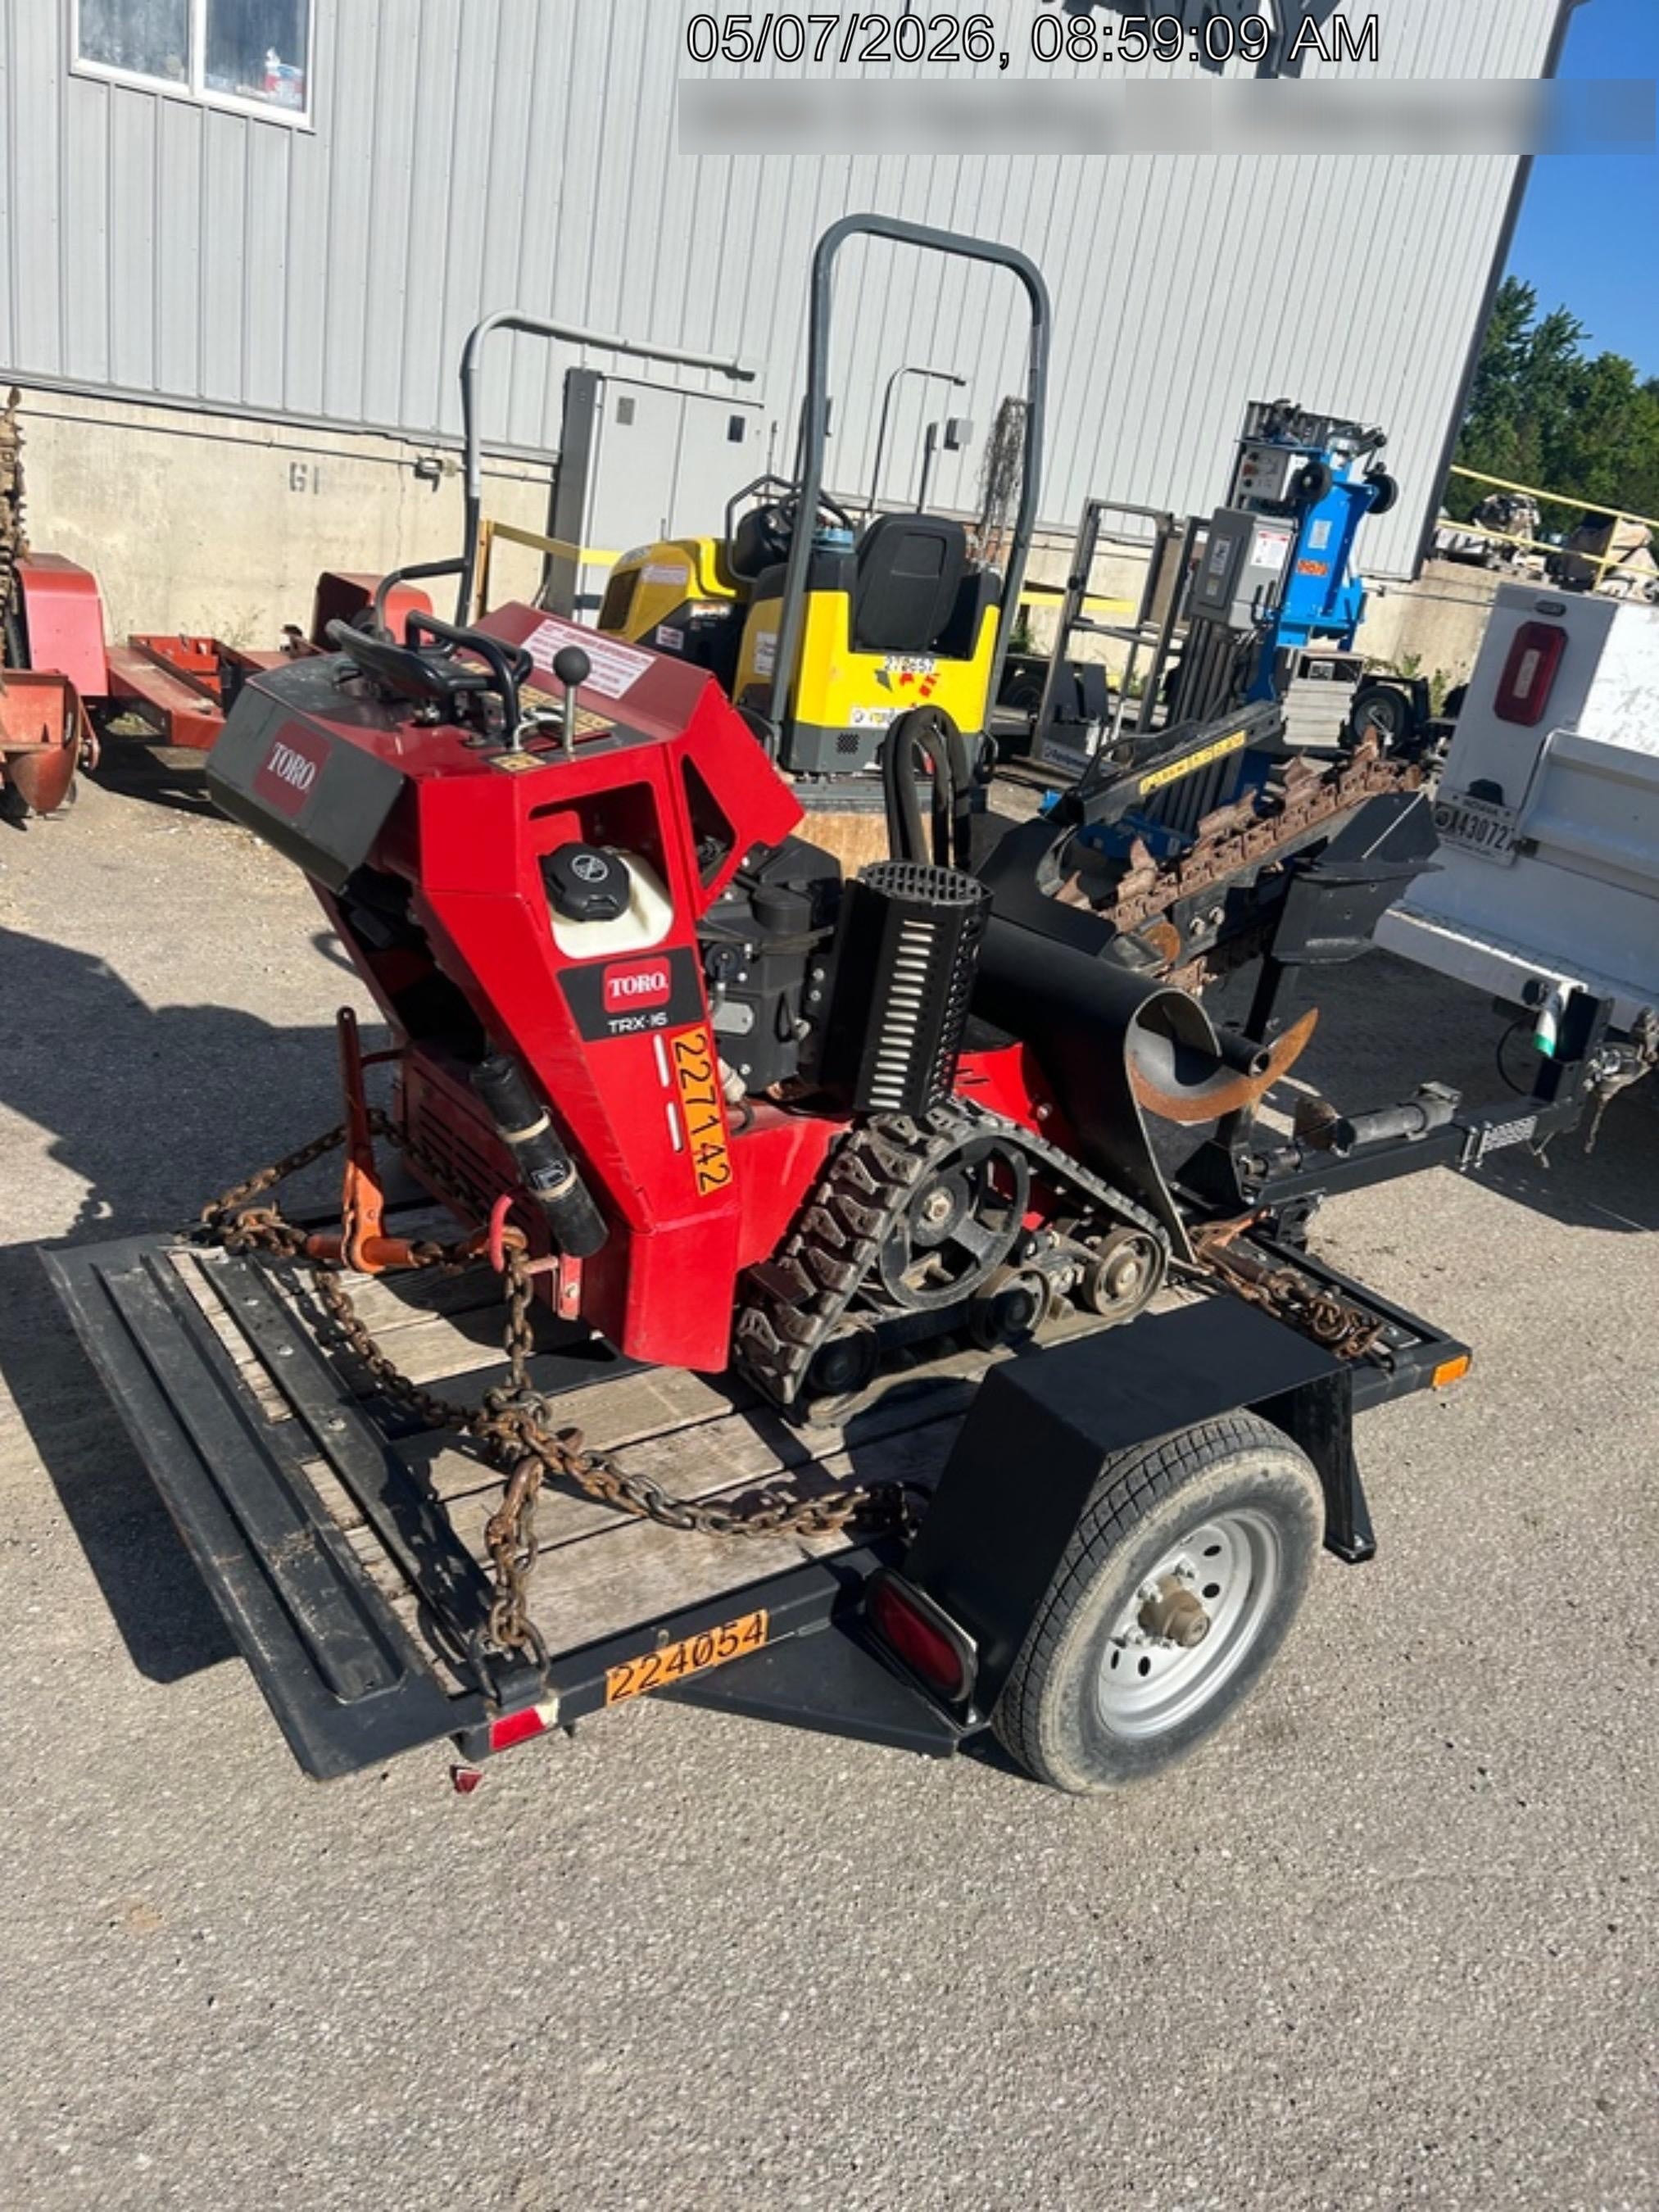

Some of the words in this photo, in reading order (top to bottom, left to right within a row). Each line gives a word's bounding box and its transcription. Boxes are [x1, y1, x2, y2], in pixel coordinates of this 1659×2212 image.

[267, 741, 316, 791] TORO
[609, 972, 668, 997] TORO
[674, 1033, 731, 1192] 227142
[611, 1613, 763, 1702] 224054
